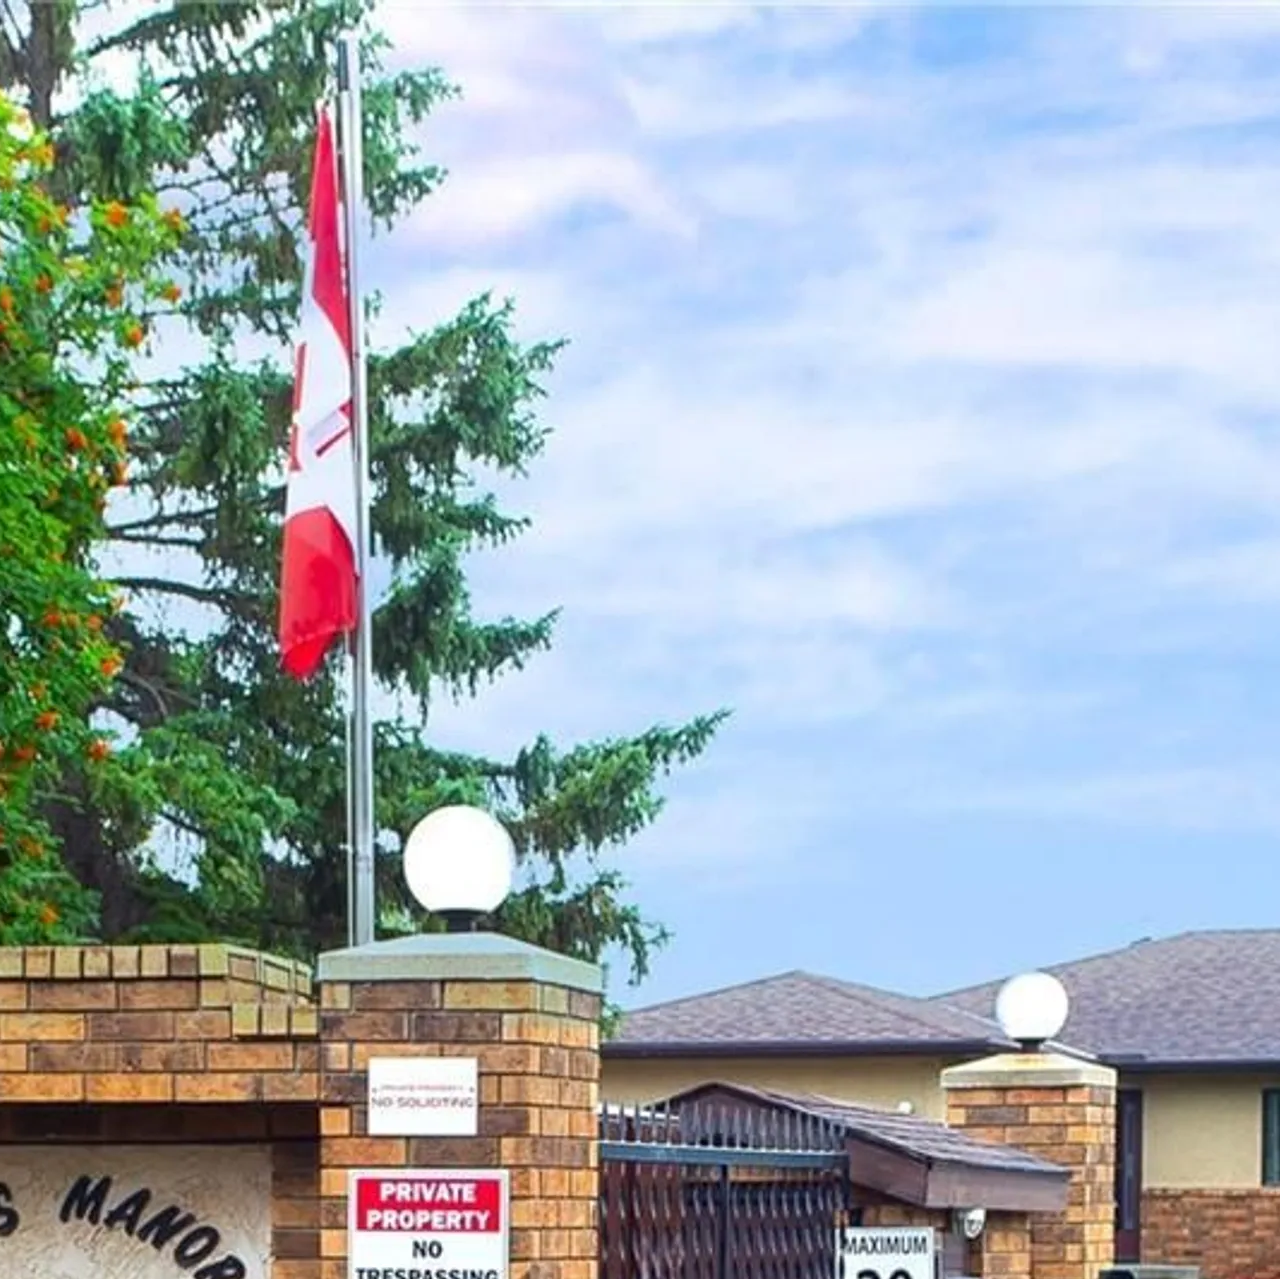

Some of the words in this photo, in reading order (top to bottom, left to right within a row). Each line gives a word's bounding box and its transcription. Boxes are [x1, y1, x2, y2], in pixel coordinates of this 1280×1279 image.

[380, 1182, 476, 1202] PRIVATE
[367, 1210, 489, 1230] PROPERTY
[412, 1241, 444, 1259] NO
[842, 1236, 927, 1254] MAXIMUM
